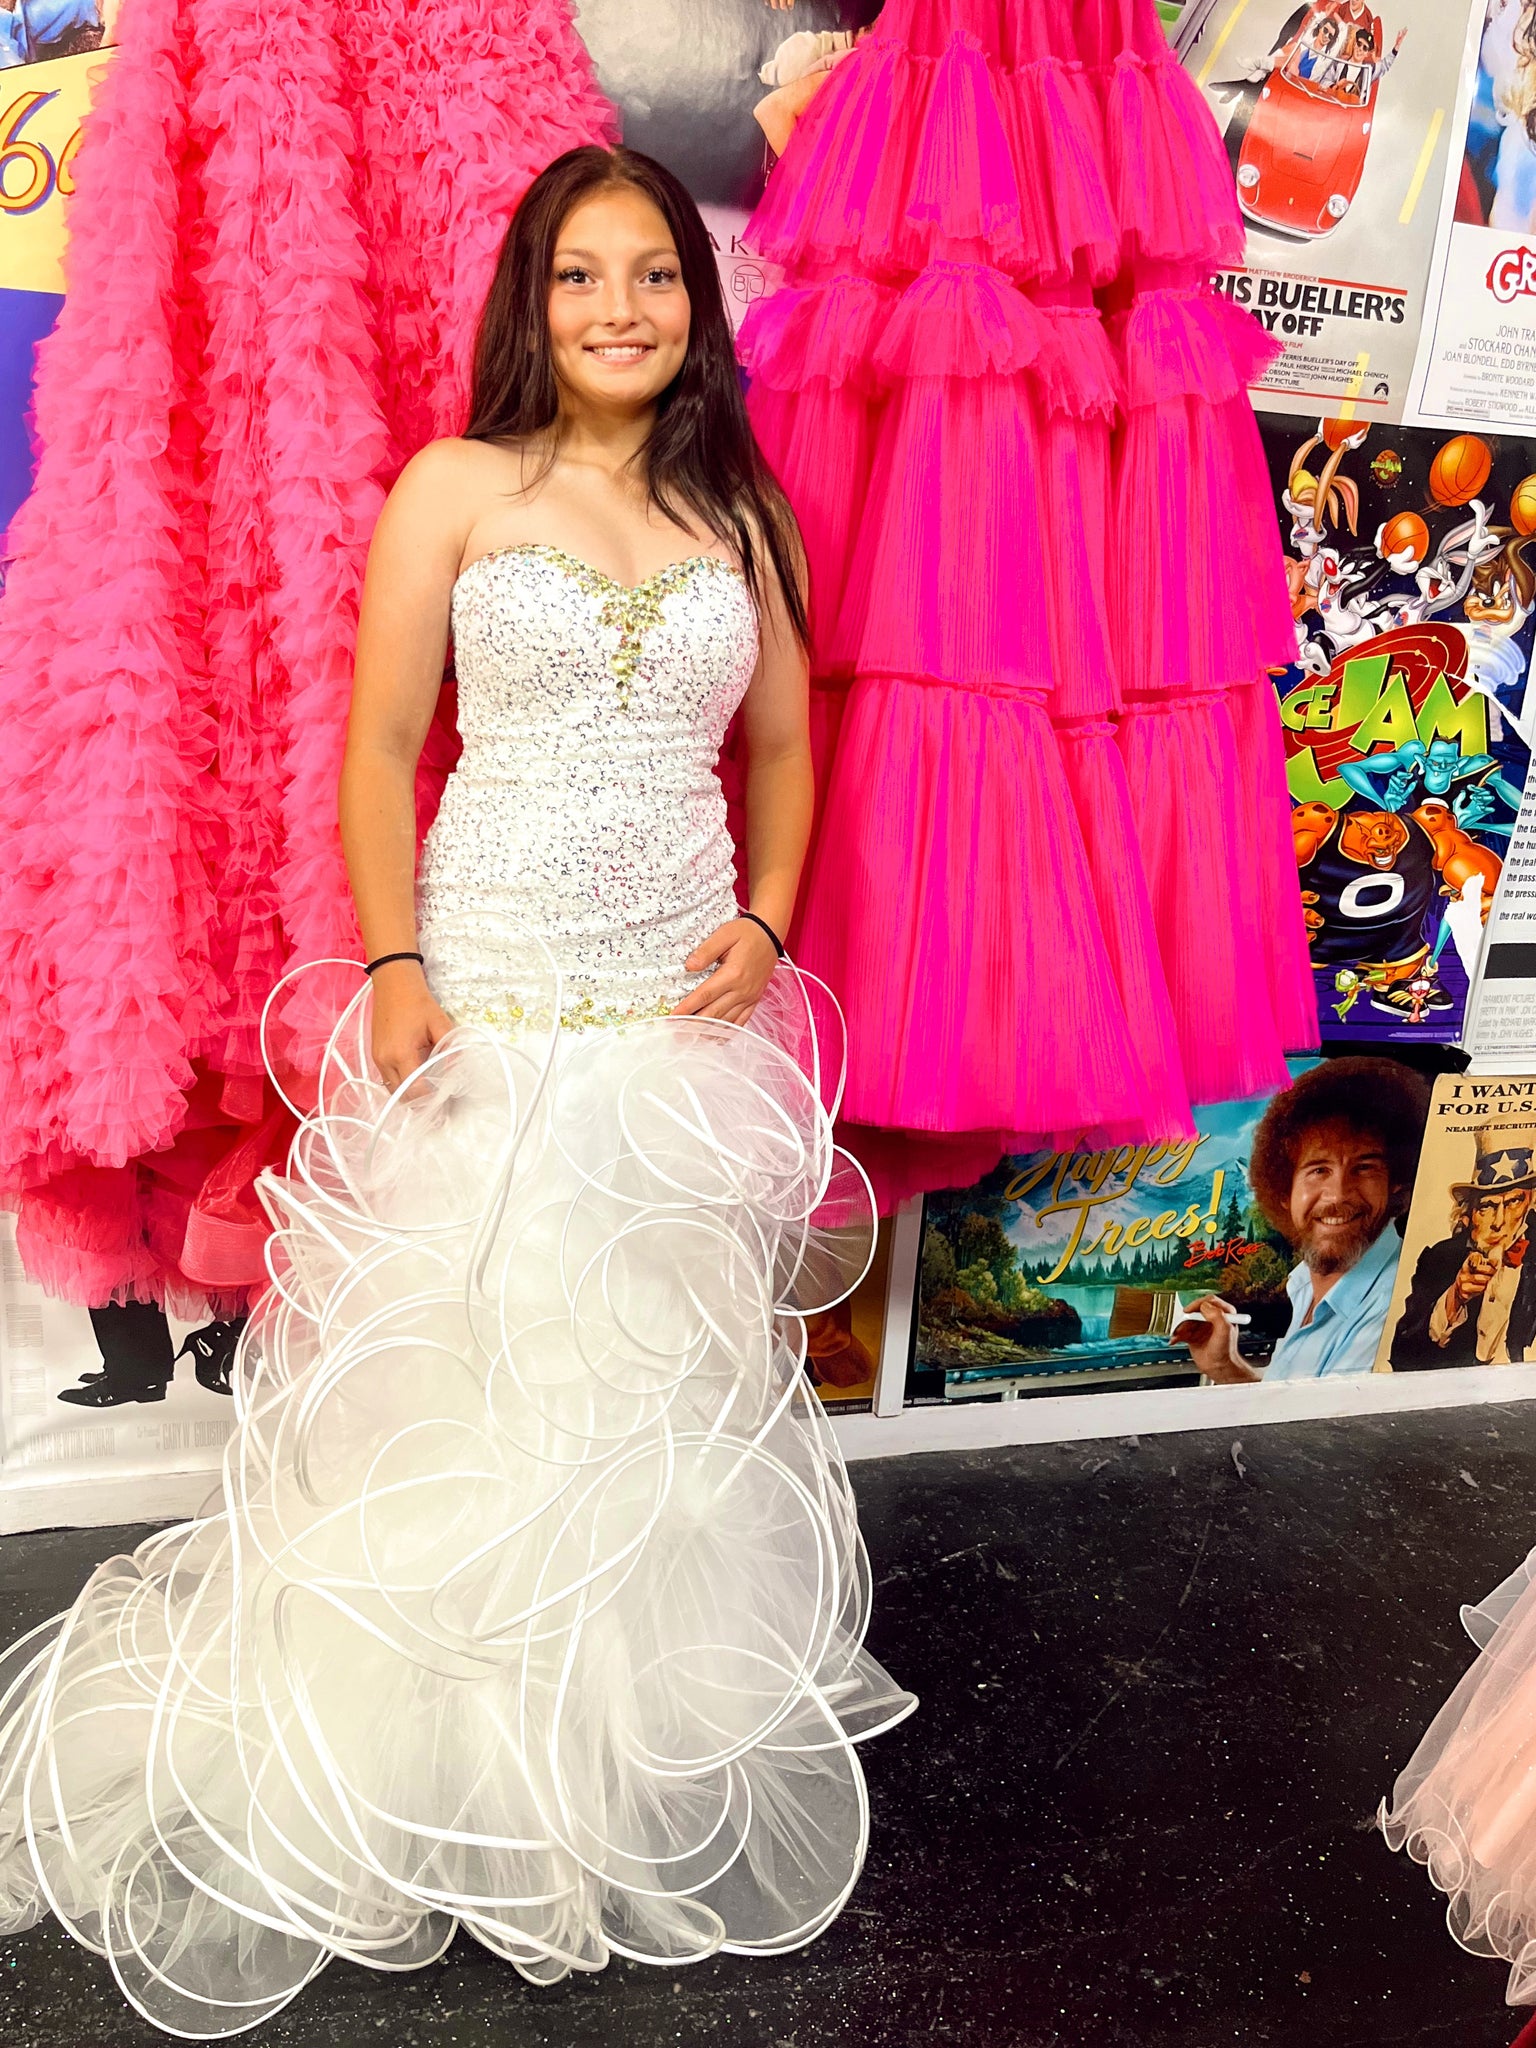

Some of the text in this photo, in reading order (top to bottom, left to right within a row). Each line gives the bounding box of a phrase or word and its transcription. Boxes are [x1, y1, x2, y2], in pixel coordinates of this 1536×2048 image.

[1248, 268, 1317, 282] MATTHEW BRODERICK
[1208, 272, 1405, 324] RIS BUELLER'S
[1250, 309, 1324, 337] AY OFF
[1495, 324, 1519, 340] JOHN
[1467, 336, 1512, 355] STOCKARD
[1282, 353, 1303, 362] FERRIS
[1303, 356, 1334, 366] BUELLER'S
[1442, 350, 1463, 363] JOAN
[1500, 358, 1515, 370] EDD
[1279, 361, 1295, 370] PAUL
[1296, 364, 1320, 372] HIRSCH
[1335, 368, 1363, 377] MICHAEL
[1310, 373, 1328, 381] JOHN
[1327, 376, 1354, 384] HUGHES
[1285, 652, 1489, 812] JAM
[1520, 807, 1533, 817] the
[1517, 824, 1529, 833] the
[1513, 840, 1525, 850] the
[1509, 857, 1521, 867] the
[1506, 872, 1518, 882] the
[1503, 889, 1514, 898] the
[1499, 911, 1510, 921] the
[1510, 911, 1526, 921] real
[1451, 1082, 1536, 1099] I WANT
[1436, 1103, 1490, 1116] FOR
[1444, 1124, 1492, 1133] NEAREST
[1004, 1132, 1212, 1203] Happy
[1035, 1169, 1226, 1285] Trees!
[1183, 1236, 1266, 1269] Bob Ross
